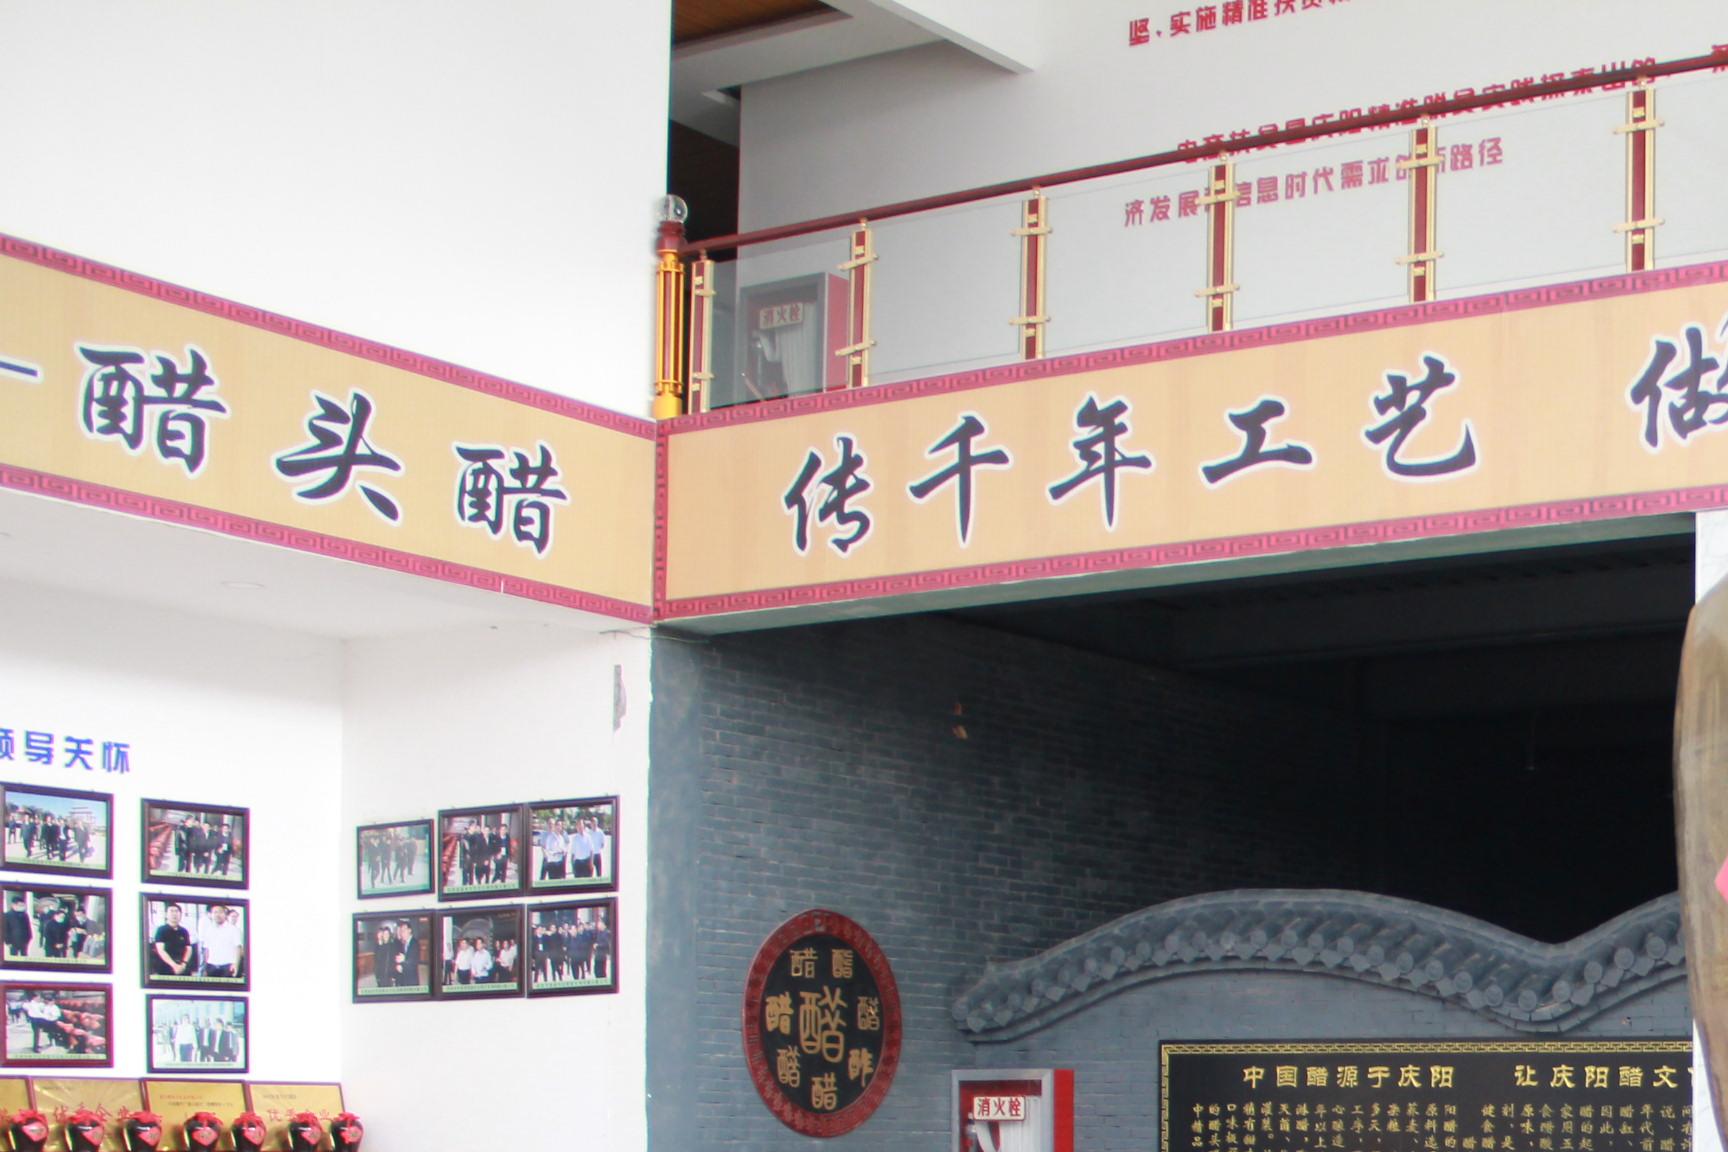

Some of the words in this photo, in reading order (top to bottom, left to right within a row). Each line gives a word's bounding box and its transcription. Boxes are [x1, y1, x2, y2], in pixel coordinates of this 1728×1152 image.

[784, 355, 1478, 552] 传千年工艺
[1242, 1064, 1456, 1089] 中国醋源于庆阳
[1513, 1064, 1693, 1089] 让庆阳醋文
[976, 1098, 1022, 1117] 消火栓
